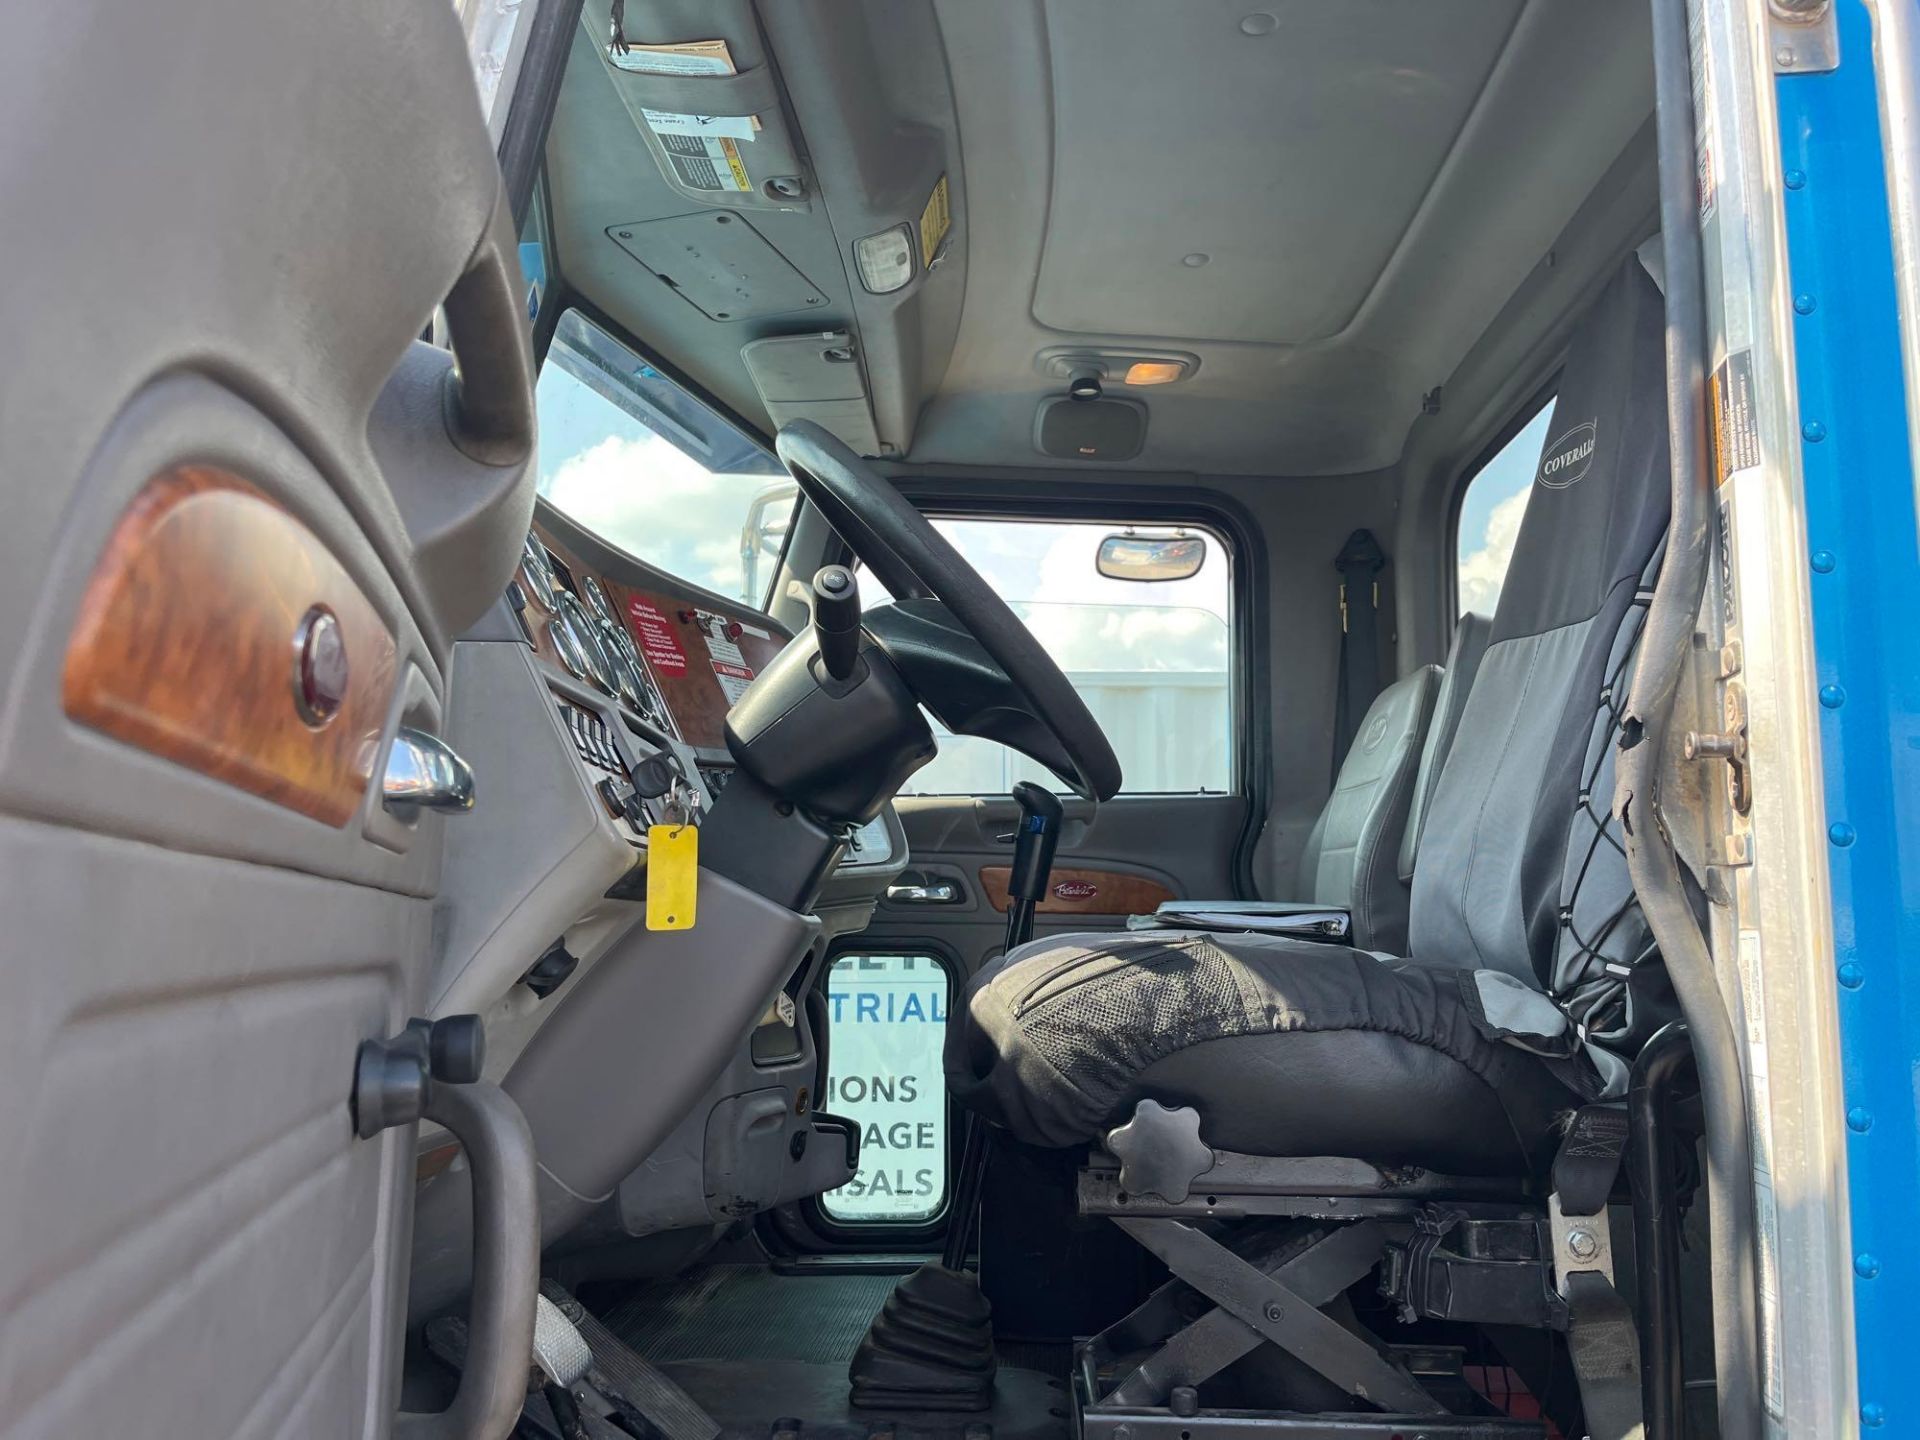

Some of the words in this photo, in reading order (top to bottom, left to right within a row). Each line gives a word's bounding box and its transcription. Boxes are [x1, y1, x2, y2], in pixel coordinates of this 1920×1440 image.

[1720, 507, 1733, 622] PACCAR
[829, 993, 946, 1022] TRIAL
[829, 1076, 917, 1102] IONS
[861, 1122, 934, 1149] AGE
